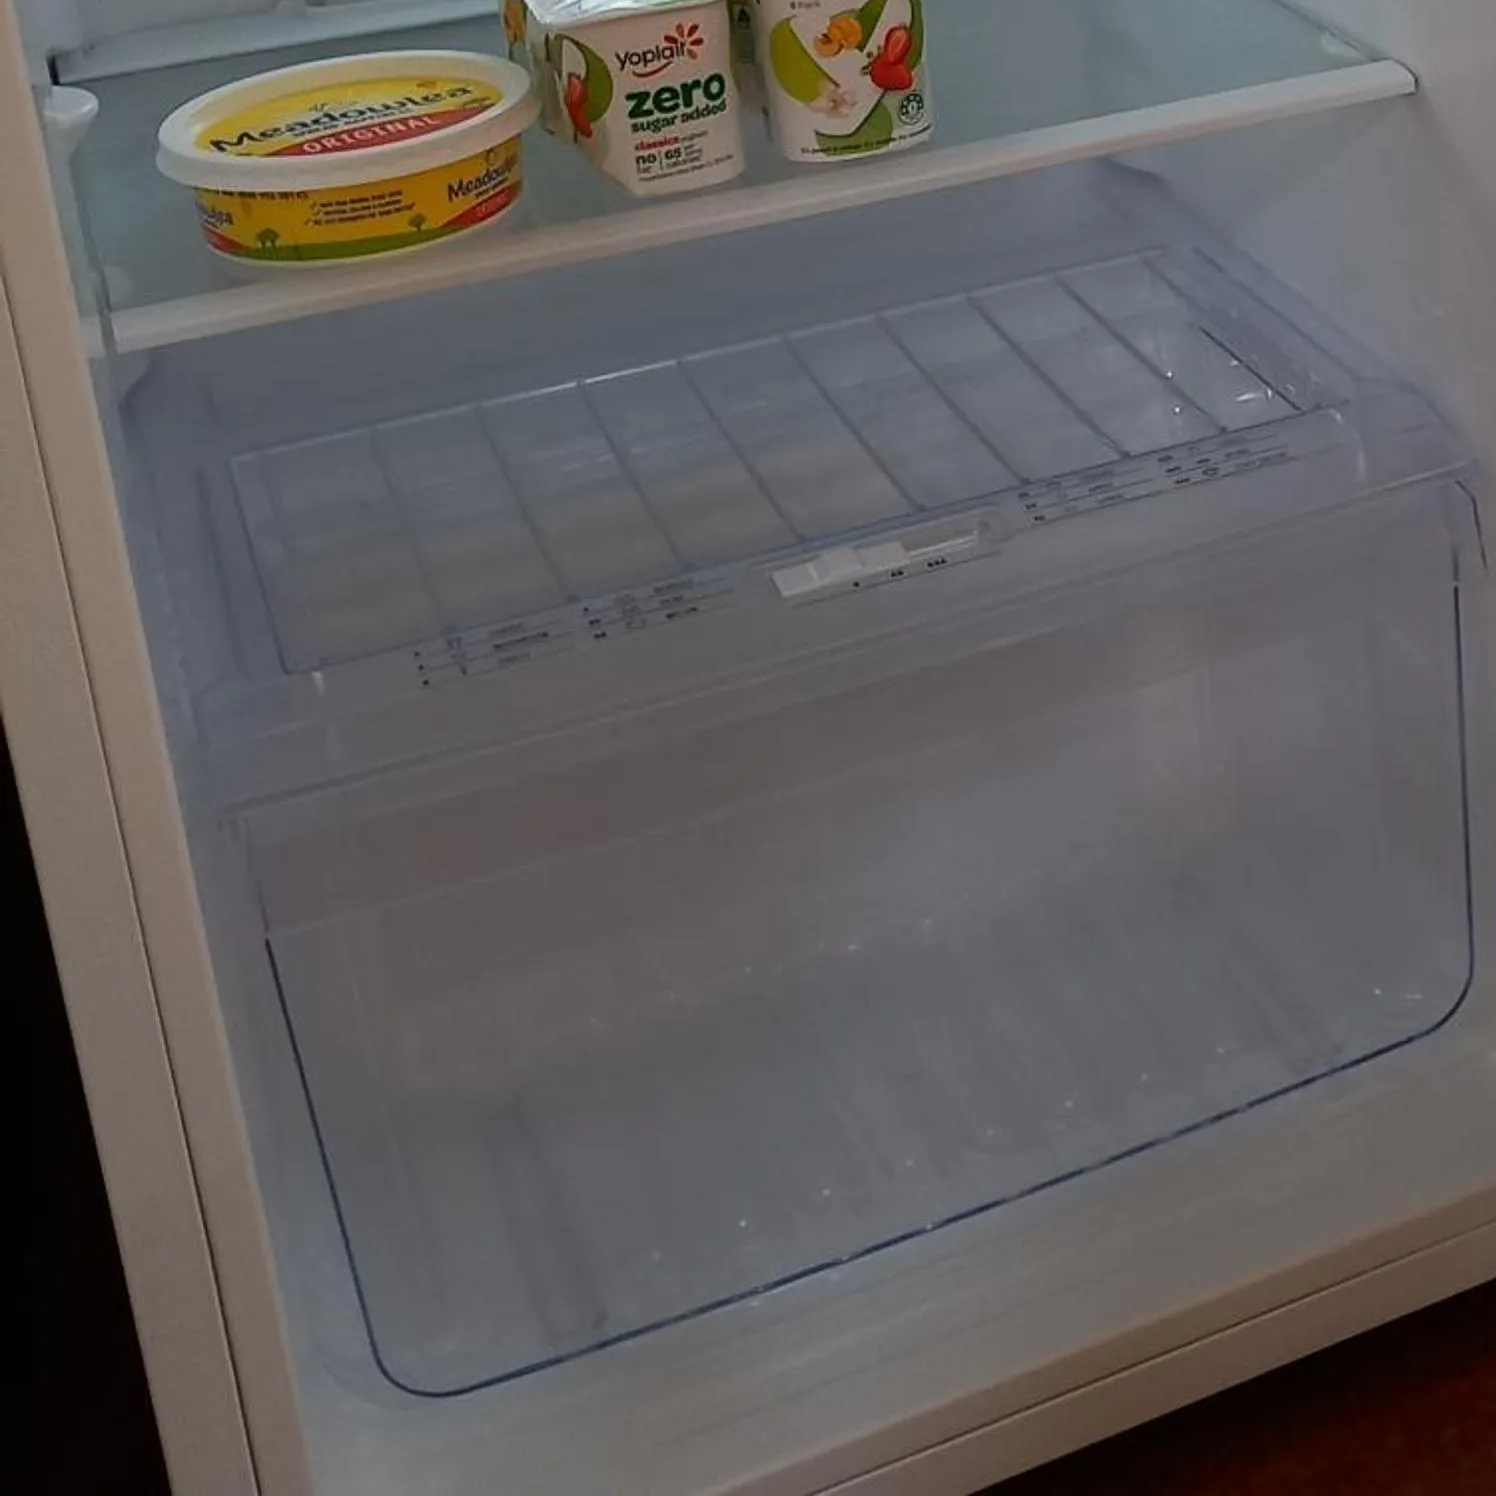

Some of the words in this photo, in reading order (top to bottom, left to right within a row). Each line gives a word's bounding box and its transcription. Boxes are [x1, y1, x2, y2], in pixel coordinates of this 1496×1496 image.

[626, 73, 726, 119] zero
[302, 115, 440, 154] ORIGINAL
[631, 115, 678, 134] sugar
[681, 99, 727, 123] added
